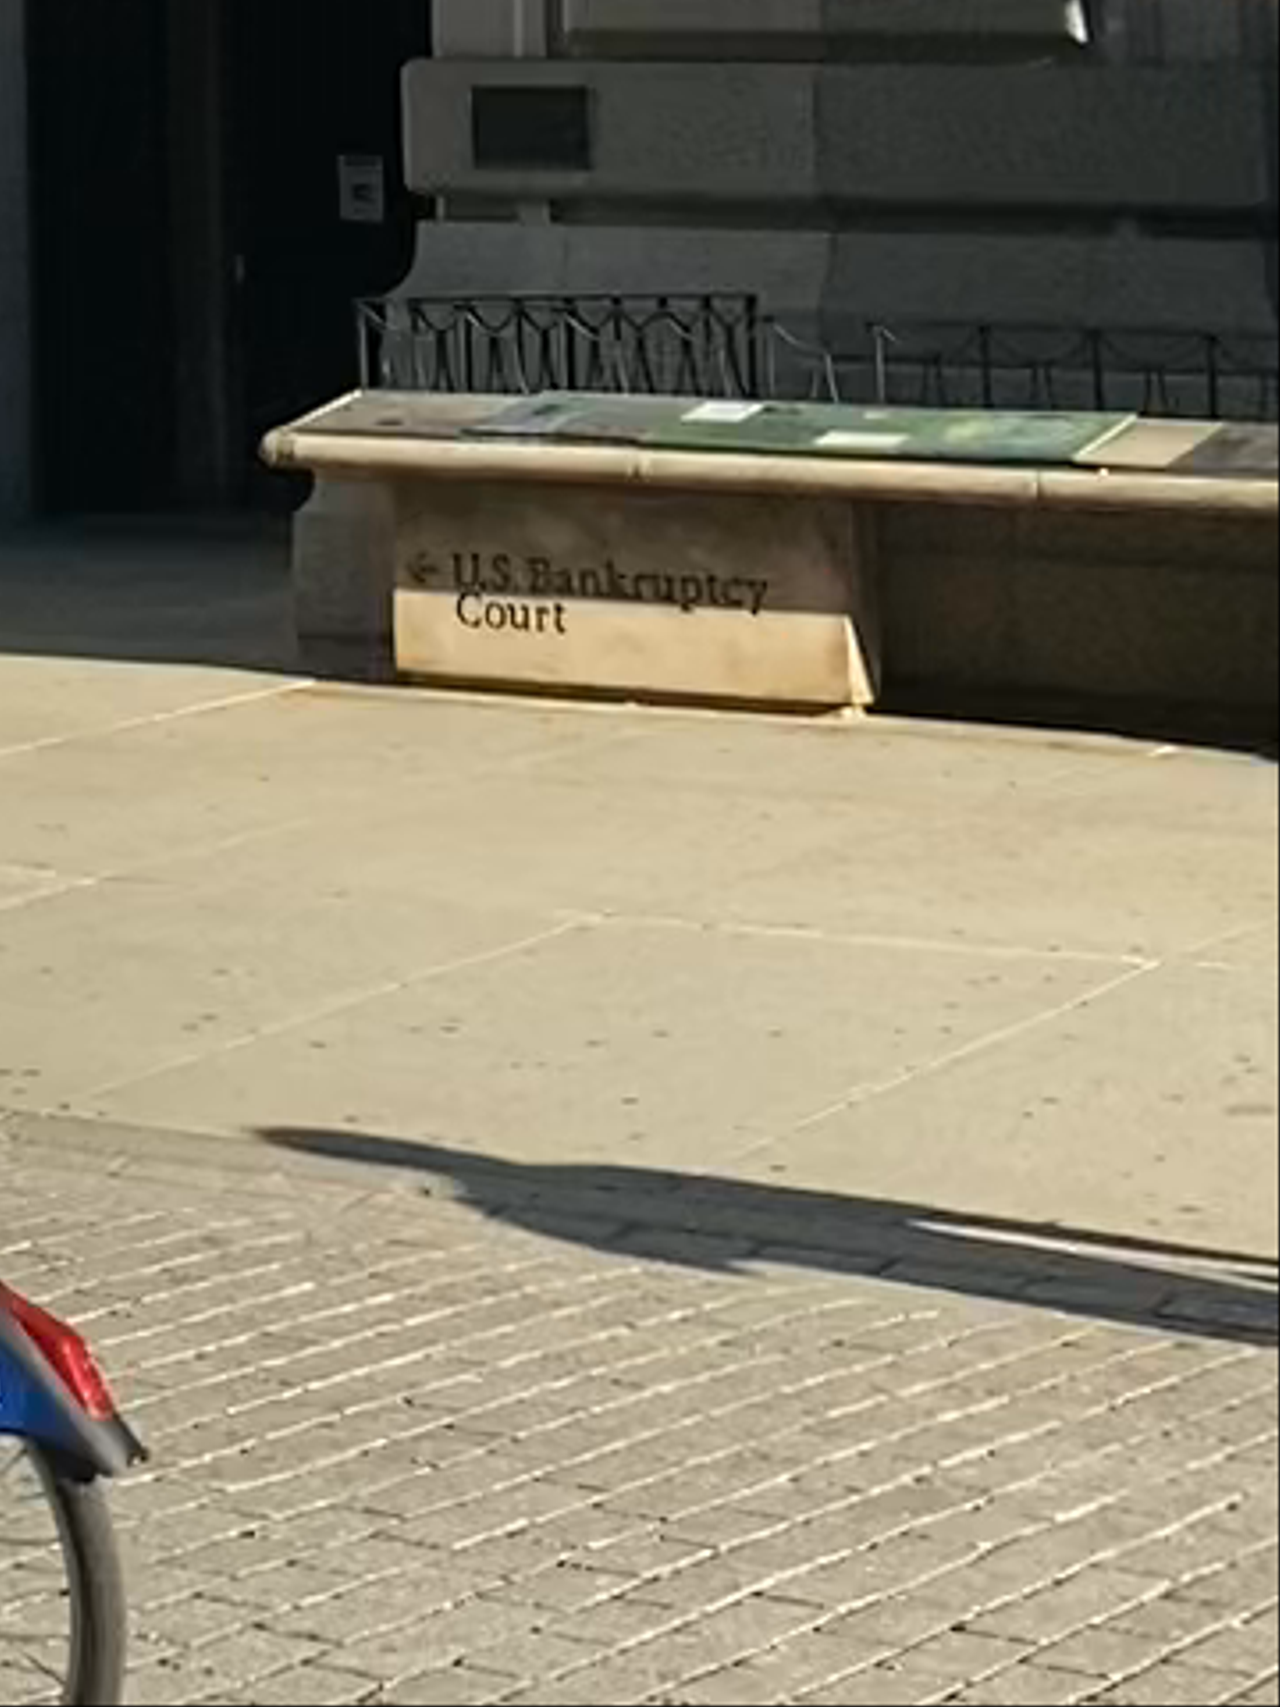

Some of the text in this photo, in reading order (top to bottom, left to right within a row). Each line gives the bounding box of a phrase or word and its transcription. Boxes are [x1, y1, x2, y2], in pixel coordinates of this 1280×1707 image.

[452, 553, 768, 615] U.S. Bankruptcy
[456, 592, 566, 634] Court
